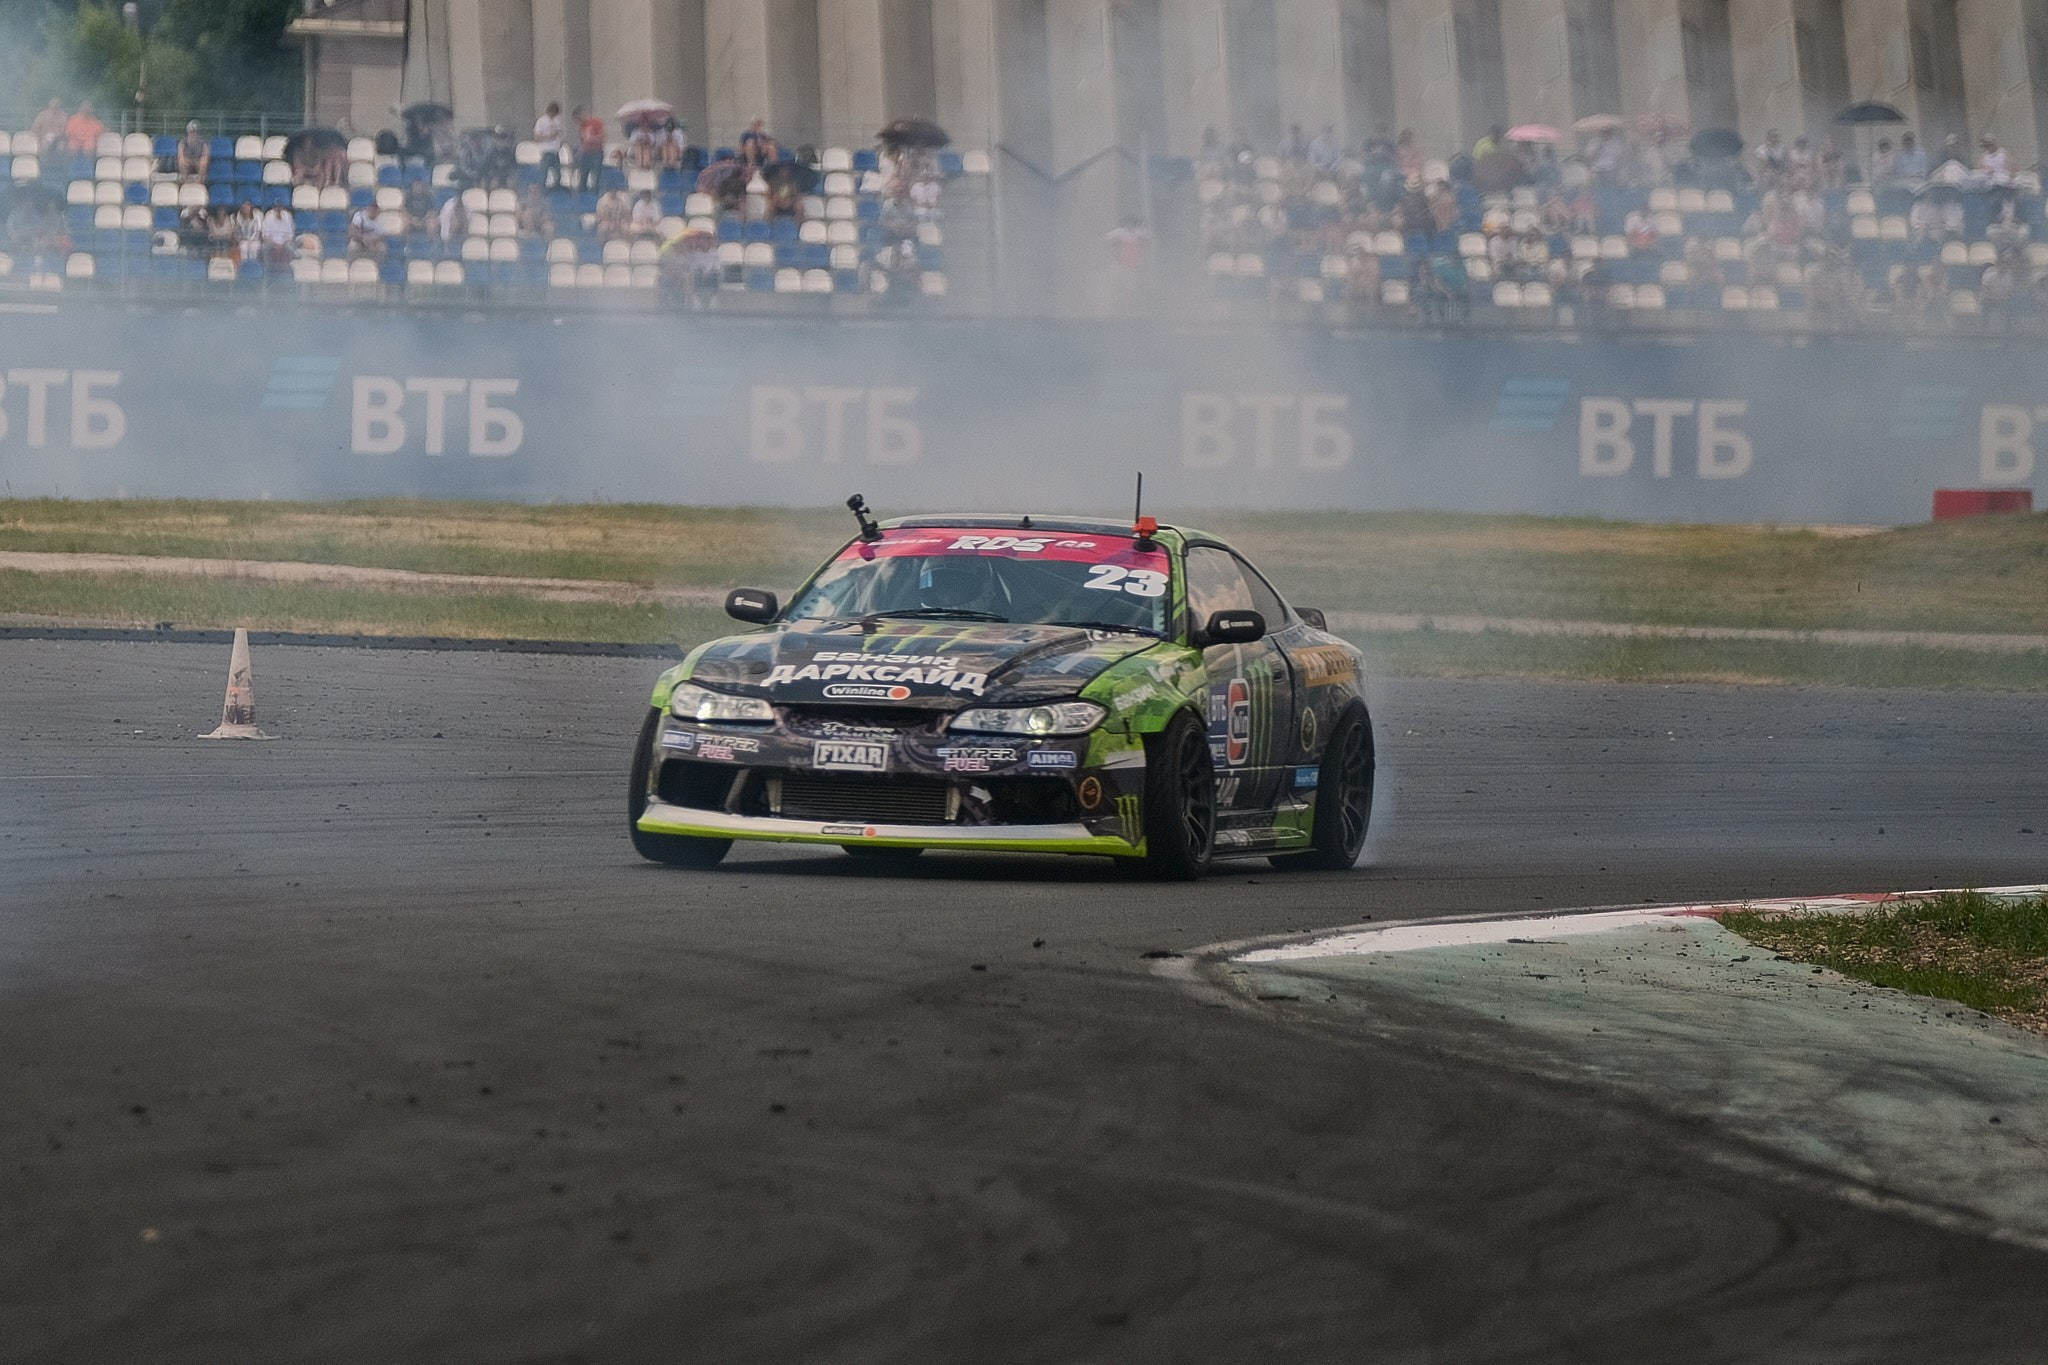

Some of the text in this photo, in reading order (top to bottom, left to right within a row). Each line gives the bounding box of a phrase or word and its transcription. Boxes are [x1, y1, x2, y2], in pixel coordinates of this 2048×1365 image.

[0, 368, 127, 449] ТБ
[352, 376, 524, 457] ВТБ
[749, 385, 923, 465] ВТБ
[1180, 391, 1352, 470] ВТБ
[1580, 397, 1752, 479] ВТБ
[947, 535, 1056, 551] RDS
[1083, 564, 1168, 597] 23
[759, 664, 988, 697] ДАРКСАЙД
[695, 733, 759, 752] HYPER
[697, 743, 734, 760] FUEL
[819, 745, 882, 764] FIXAR
[937, 747, 1018, 760] HYPER
[943, 757, 990, 771] FUEL
